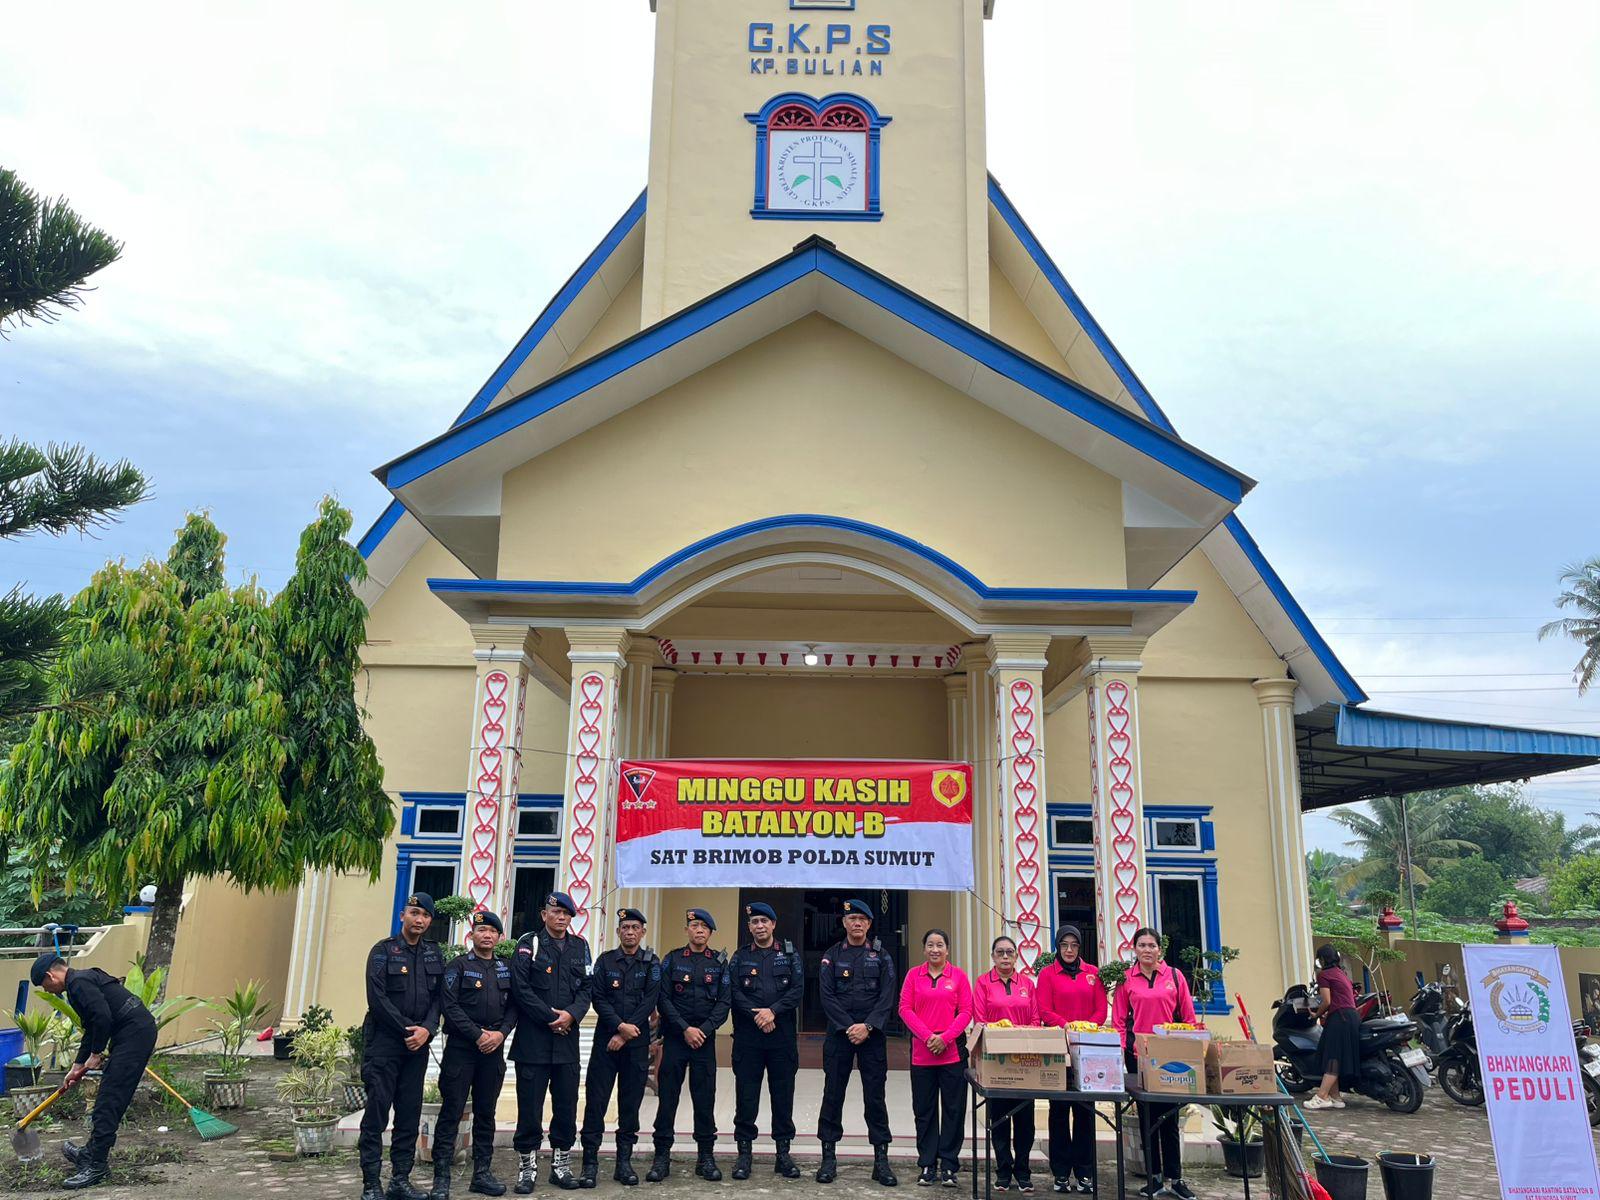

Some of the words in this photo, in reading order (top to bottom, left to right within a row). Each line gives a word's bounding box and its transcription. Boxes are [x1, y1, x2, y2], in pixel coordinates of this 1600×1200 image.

[749, 23, 891, 54] G.K.P.S
[751, 58, 778, 74] KP.
[787, 59, 882, 75] BULIAN
[800, 135, 848, 152] PROTESTAN
[778, 142, 799, 171] KRISTEN
[778, 172, 798, 200] GEREJA
[836, 152, 857, 200] SIMALUNGUN
[677, 777, 805, 804] MINGGU
[813, 778, 910, 805] KASIH
[701, 811, 855, 837] BATALYON
[863, 812, 886, 838] B
[650, 849, 687, 865] SAT
[692, 849, 783, 865] BRIMOB
[787, 849, 860, 865] POLDA
[865, 850, 935, 867] SUMUT
[1491, 966, 1538, 977] BHAYANGKARI
[1486, 1055, 1573, 1072] BHAYANGKARI
[1492, 1077, 1576, 1101] PEDULI
